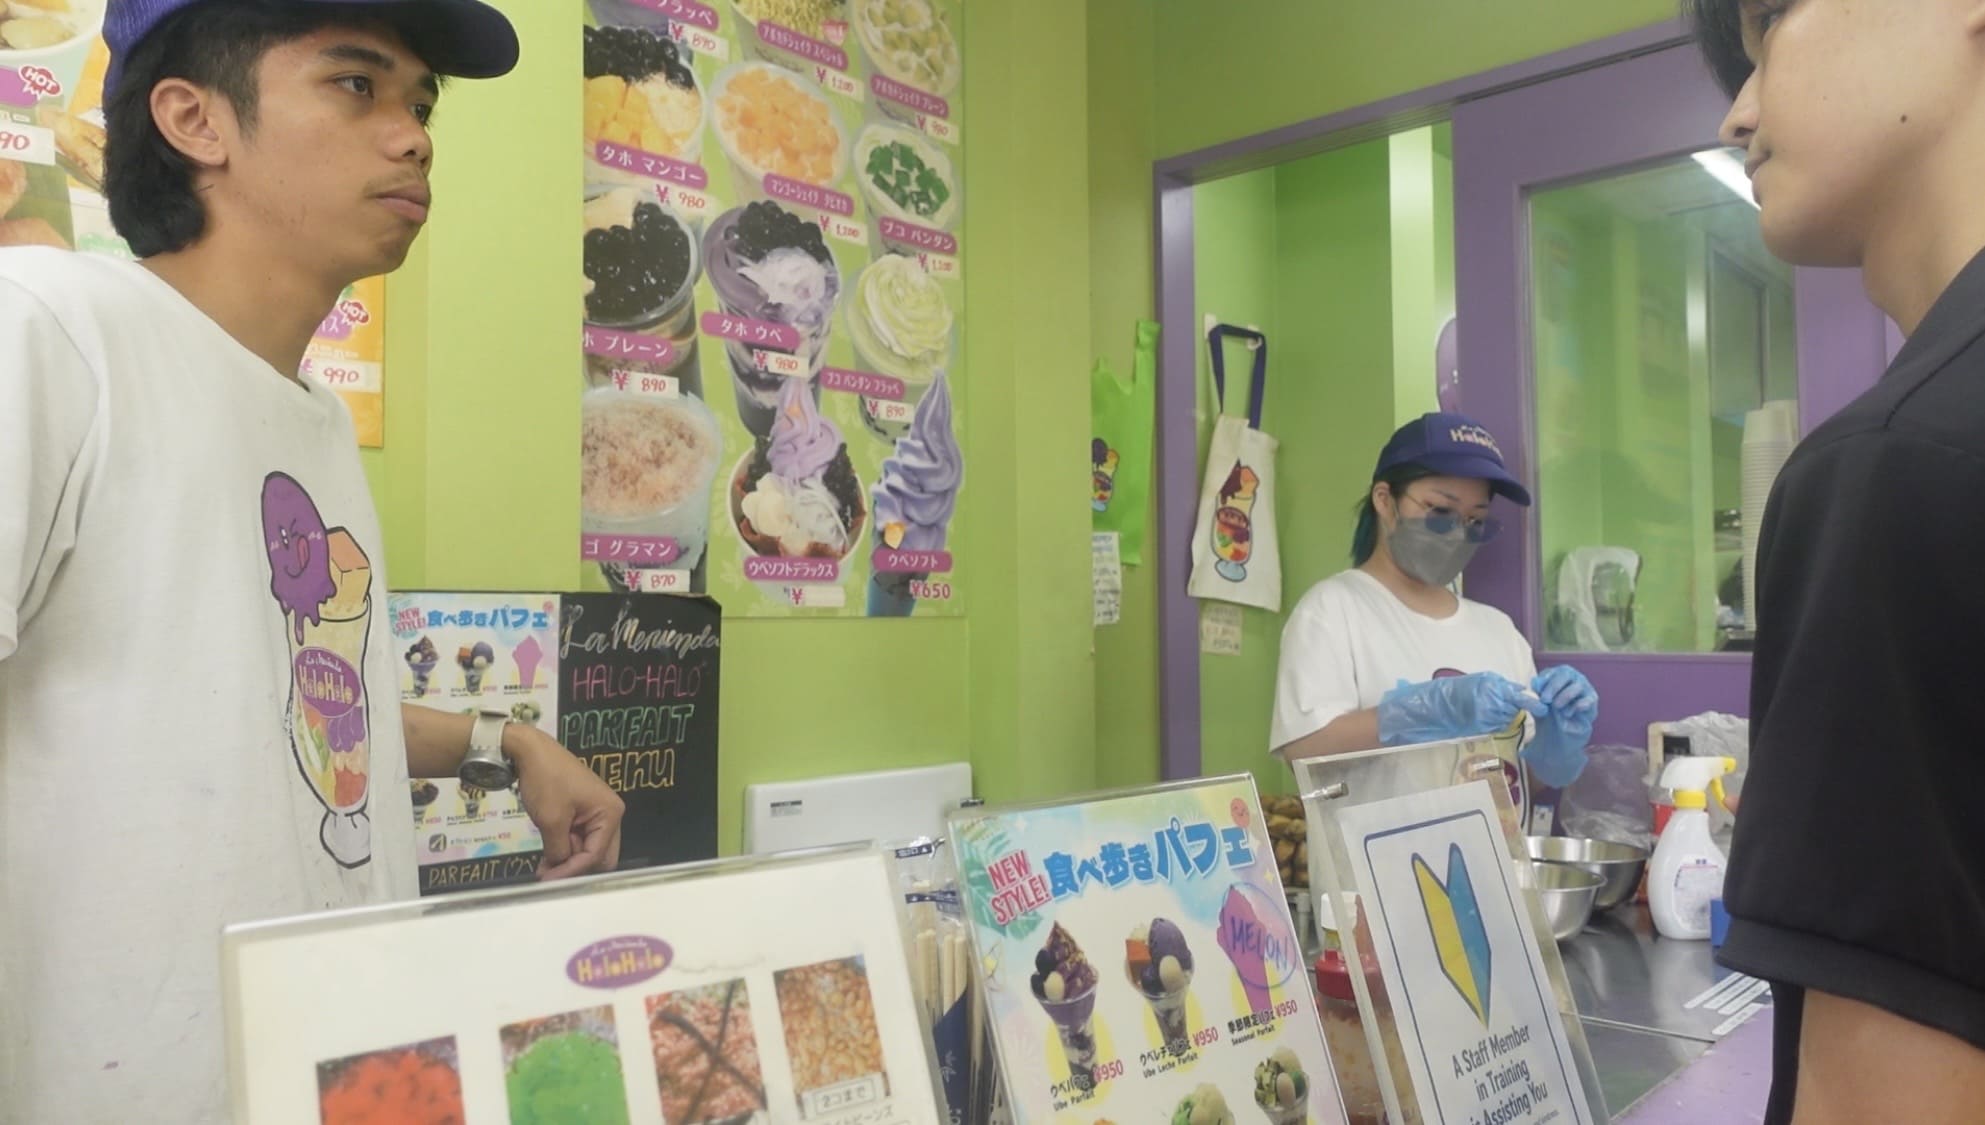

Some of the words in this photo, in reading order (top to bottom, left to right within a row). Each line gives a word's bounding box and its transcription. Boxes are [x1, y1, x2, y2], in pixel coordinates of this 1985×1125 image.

[25, 68, 58, 91] HOT
[602, 145, 633, 167] タホ
[641, 156, 702, 181] マンゴー
[679, 192, 705, 209] 980
[342, 301, 366, 322] HOT
[721, 319, 748, 337] タホ
[604, 336, 668, 358] プレーン
[641, 377, 667, 392] 890
[609, 540, 672, 557] グラマン
[912, 581, 951, 599] ¥650
[427, 604, 548, 628] 食べ歩きパフェ
[299, 664, 353, 704] HaloHalo
[561, 704, 694, 750] PARFAIT
[987, 850, 1031, 891] NEW
[1043, 816, 1253, 898] 食べ歩きパフェ
[428, 859, 500, 888] PARFAIT
[990, 875, 1052, 925] STYLE!
[1231, 915, 1289, 972] MELON
[1192, 1026, 1219, 1048] ¥950
[1452, 1054, 1464, 1079] A
[1461, 1039, 1490, 1073] Staff
[1488, 1025, 1530, 1059] Member
[1474, 1080, 1489, 1101] in
[1485, 1060, 1530, 1094] Training
[1483, 1092, 1532, 1125] Assisting
[1527, 1081, 1548, 1104] You
